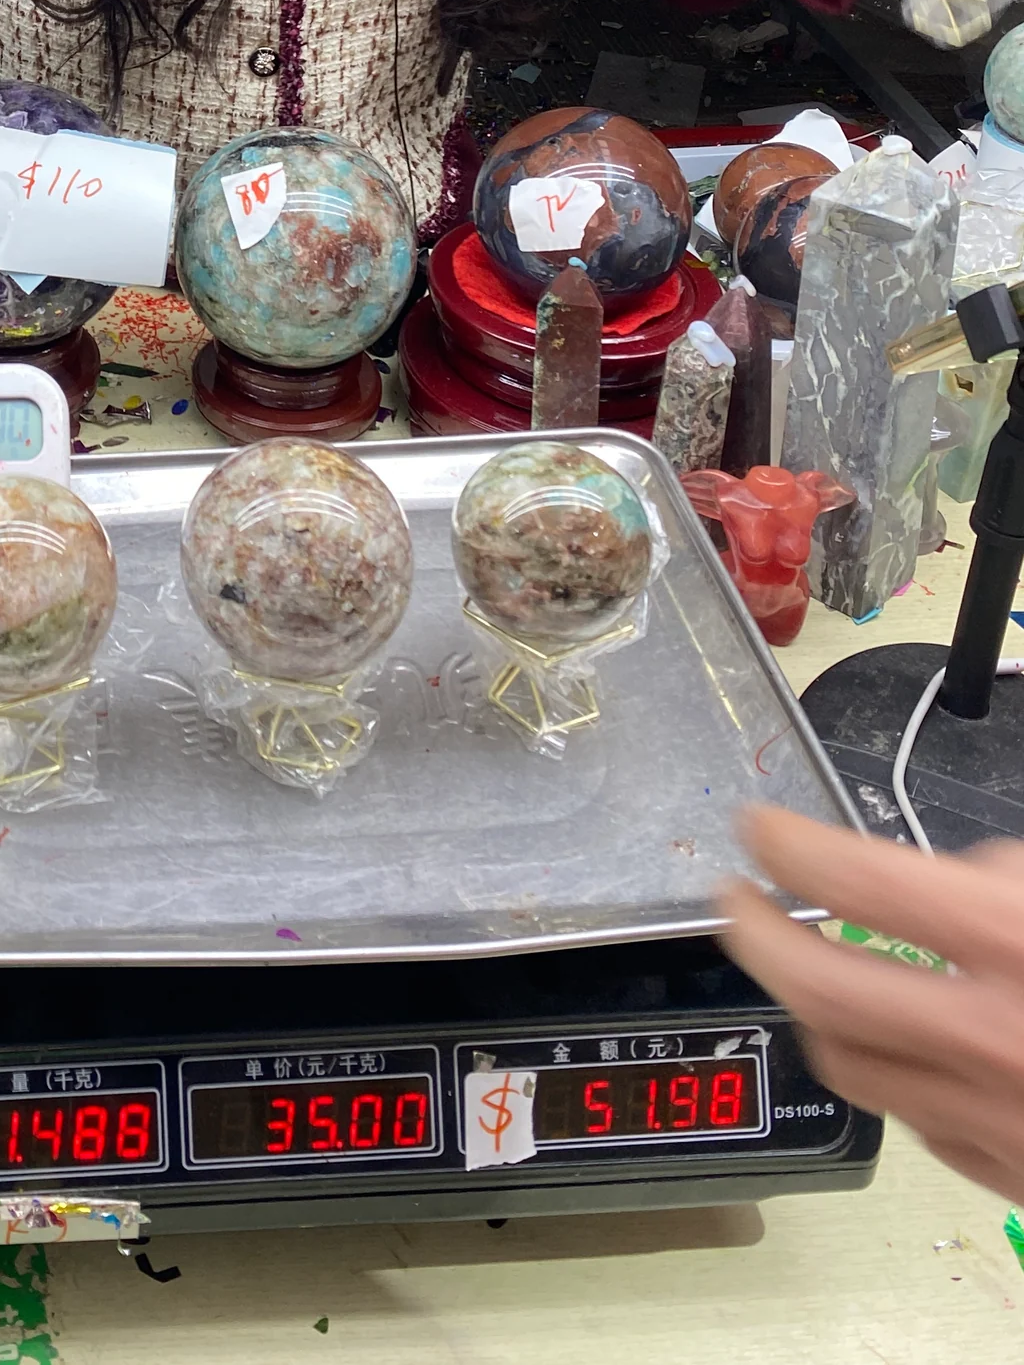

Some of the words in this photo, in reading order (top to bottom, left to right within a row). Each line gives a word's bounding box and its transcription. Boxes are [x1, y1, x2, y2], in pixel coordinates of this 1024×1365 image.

[17, 161, 104, 205] $110
[8, 1102, 152, 1164] 1.488
[266, 1092, 427, 1153] 35.00
[478, 1072, 521, 1153] $
[583, 1071, 744, 1134] 51.98
[773, 1102, 836, 1120] DS100-S
